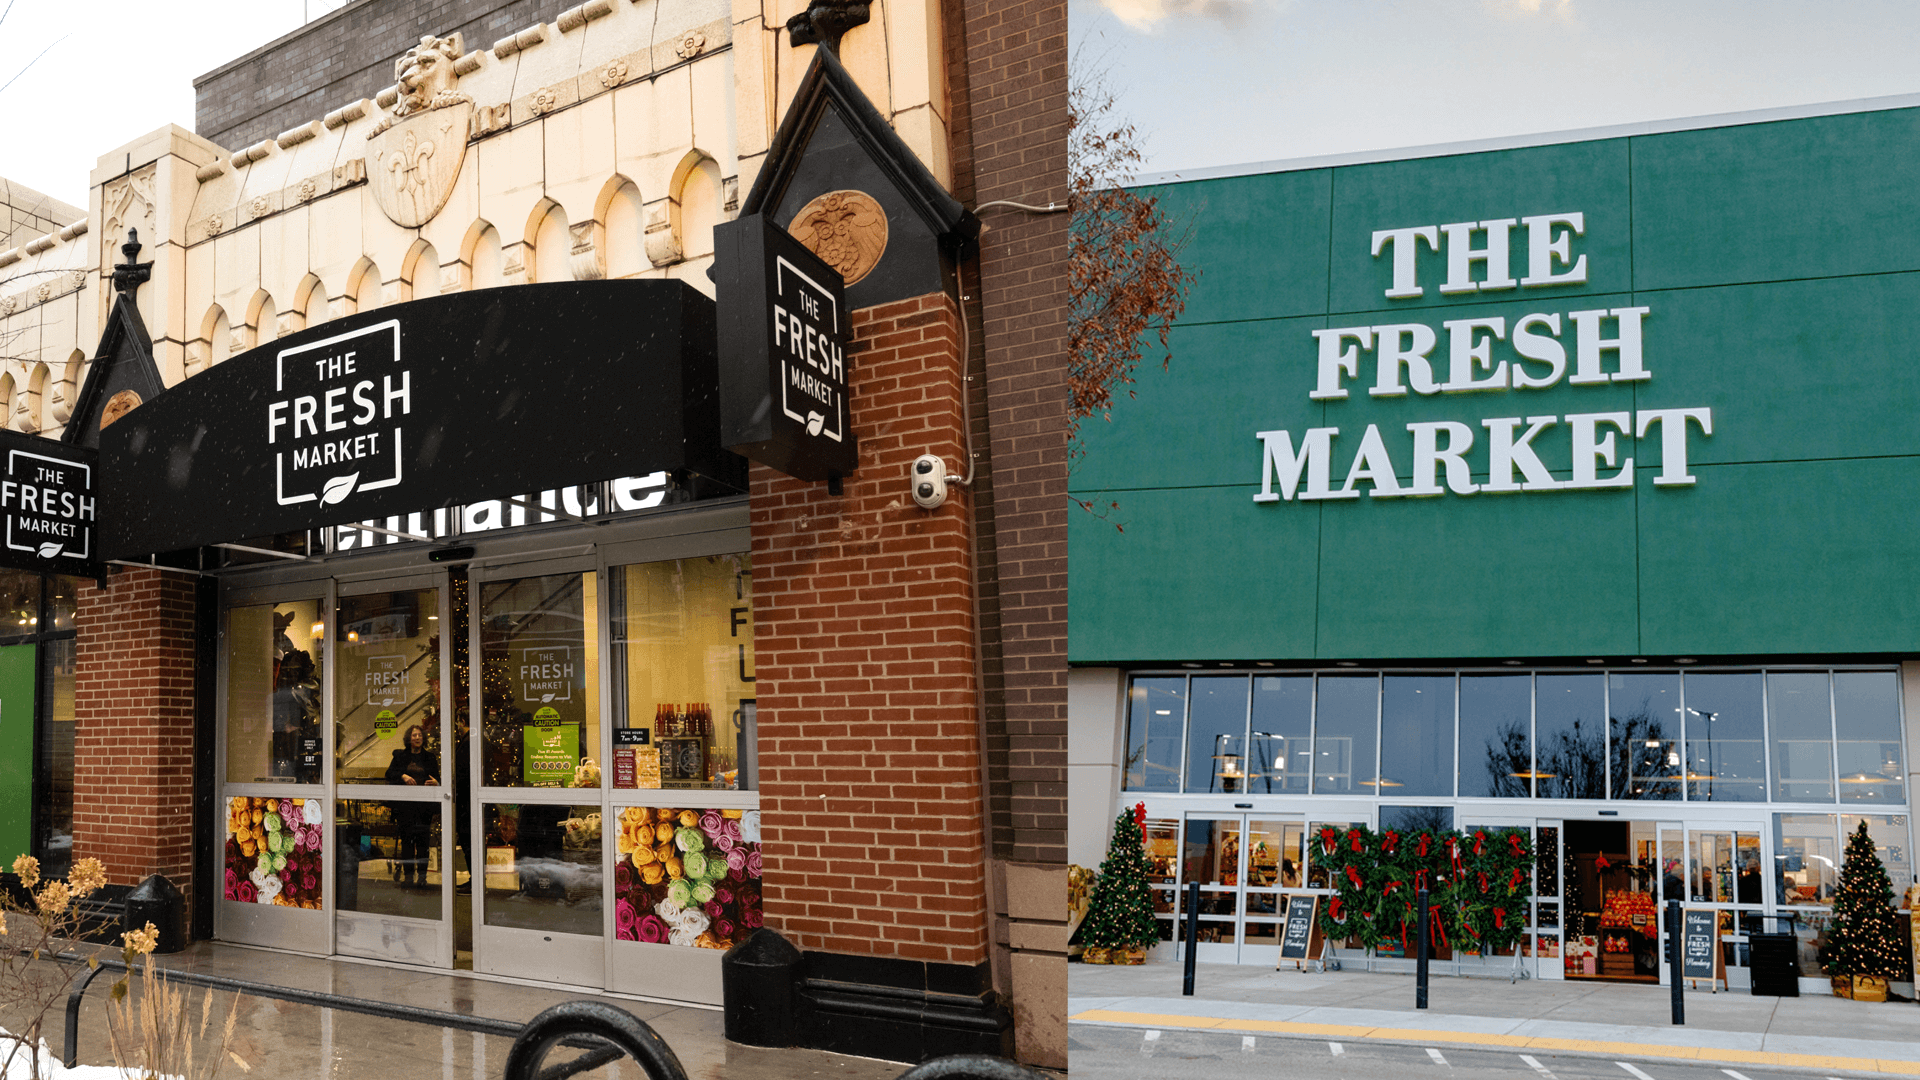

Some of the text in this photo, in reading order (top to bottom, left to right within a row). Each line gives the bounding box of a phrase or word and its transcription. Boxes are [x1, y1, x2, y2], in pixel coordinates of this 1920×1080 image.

[1371, 212, 1588, 299] THE
[799, 289, 820, 322] THE
[774, 304, 844, 384] FRESH
[1309, 306, 1653, 400] FRESH
[315, 351, 357, 382] THE
[791, 365, 832, 406] MARKET
[268, 370, 411, 444] FRESH
[293, 432, 379, 471] MARKET
[1253, 407, 1714, 503] MARKET
[37, 467, 64, 485] THE
[1, 480, 95, 521] FRESH
[20, 516, 76, 538] MARKET
[380, 661, 394, 669] THE
[520, 663, 574, 680] FRESH
[539, 653, 554, 661] THE
[365, 671, 410, 686] FRESH
[373, 687, 400, 695] MARKET
[530, 681, 562, 690] MARKET
